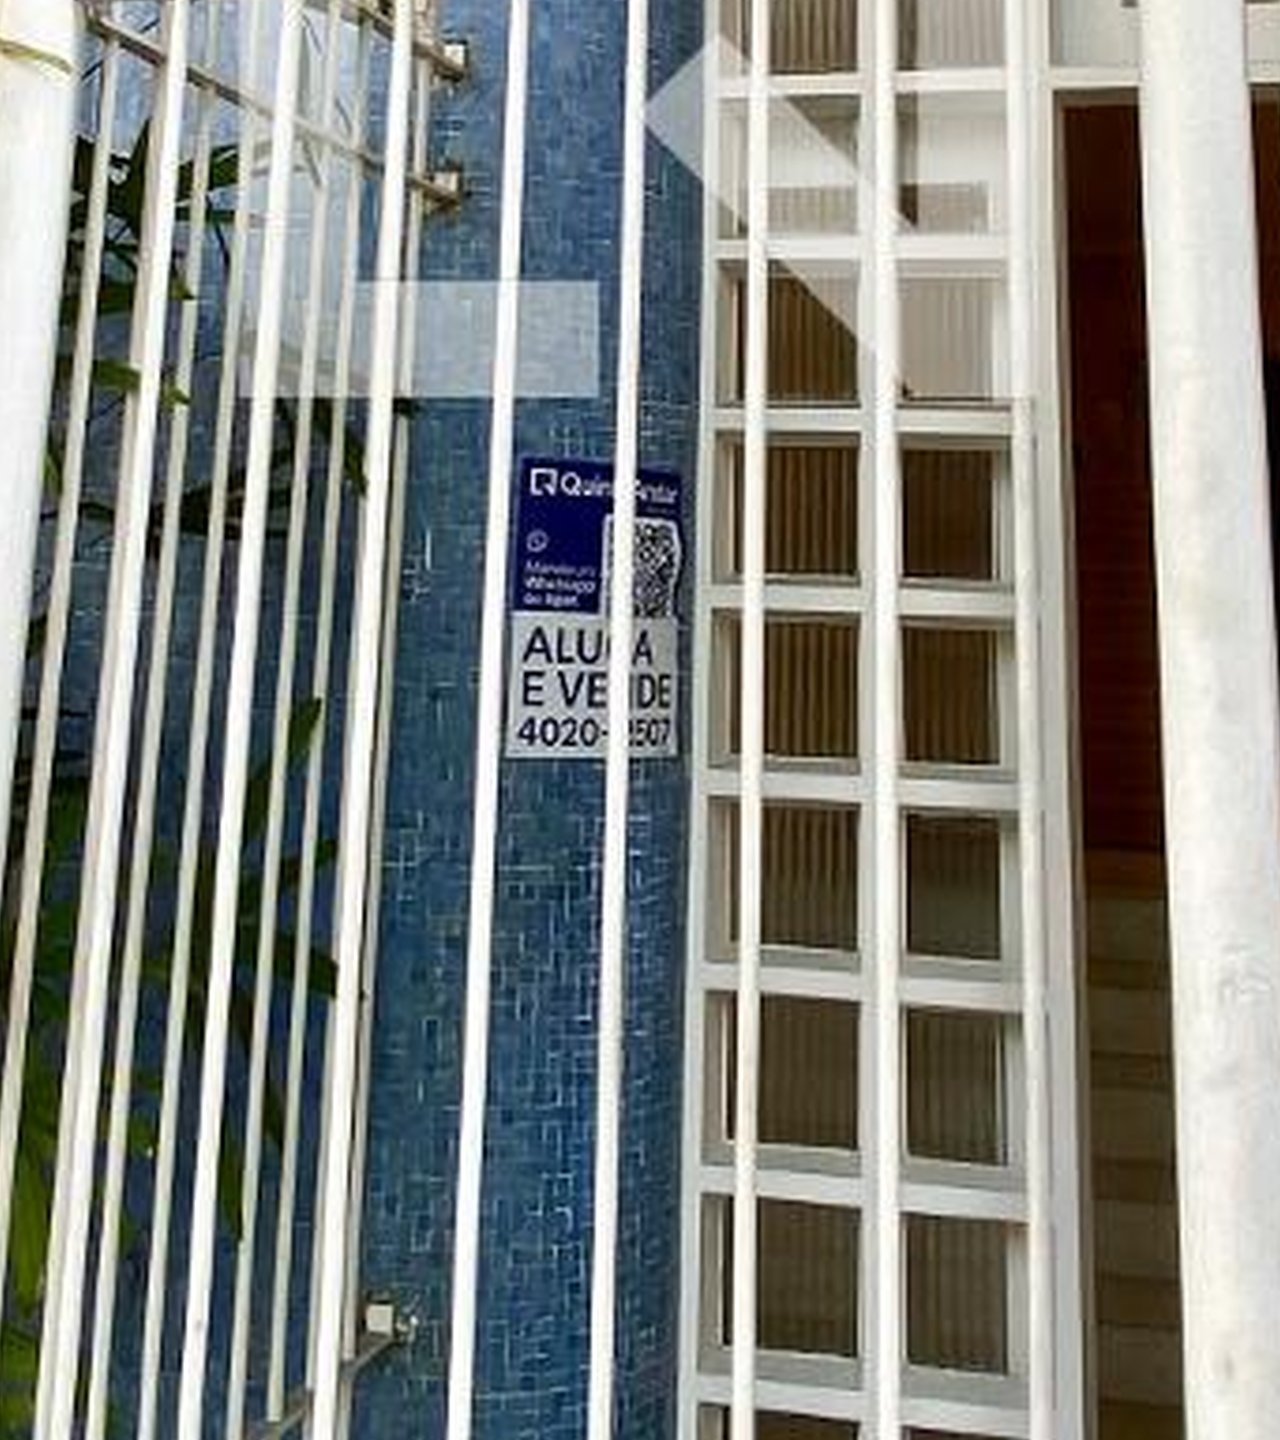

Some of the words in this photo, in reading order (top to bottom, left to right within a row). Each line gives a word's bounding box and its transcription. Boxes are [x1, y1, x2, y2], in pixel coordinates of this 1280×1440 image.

[523, 626, 653, 666] ALUA
[523, 671, 545, 706] E
[557, 671, 672, 709] VEDE
